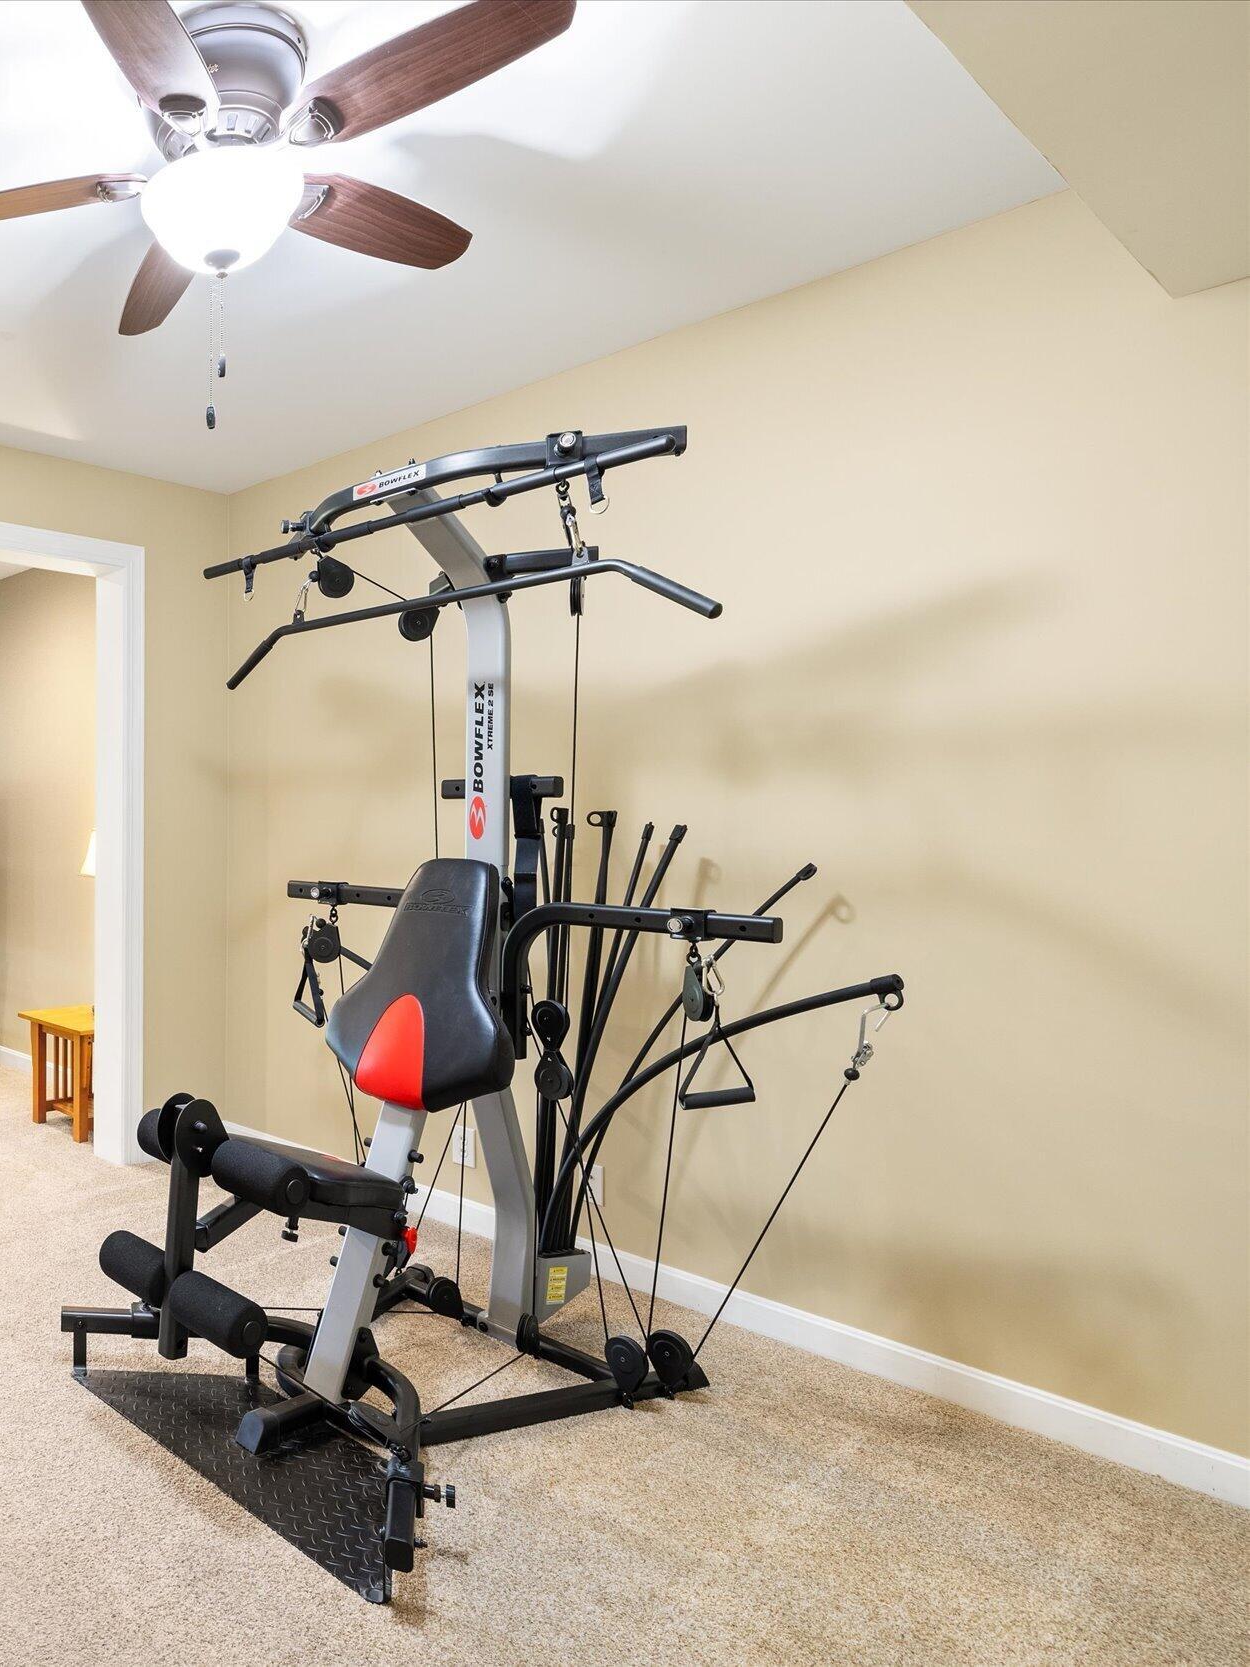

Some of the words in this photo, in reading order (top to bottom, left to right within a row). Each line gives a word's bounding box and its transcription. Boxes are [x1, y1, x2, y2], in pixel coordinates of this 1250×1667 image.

[378, 469, 420, 489] BOWFLEX
[487, 683, 494, 697] SE
[473, 682, 486, 793] BOWFLEX
[404, 903, 473, 915] BOWFLEX
